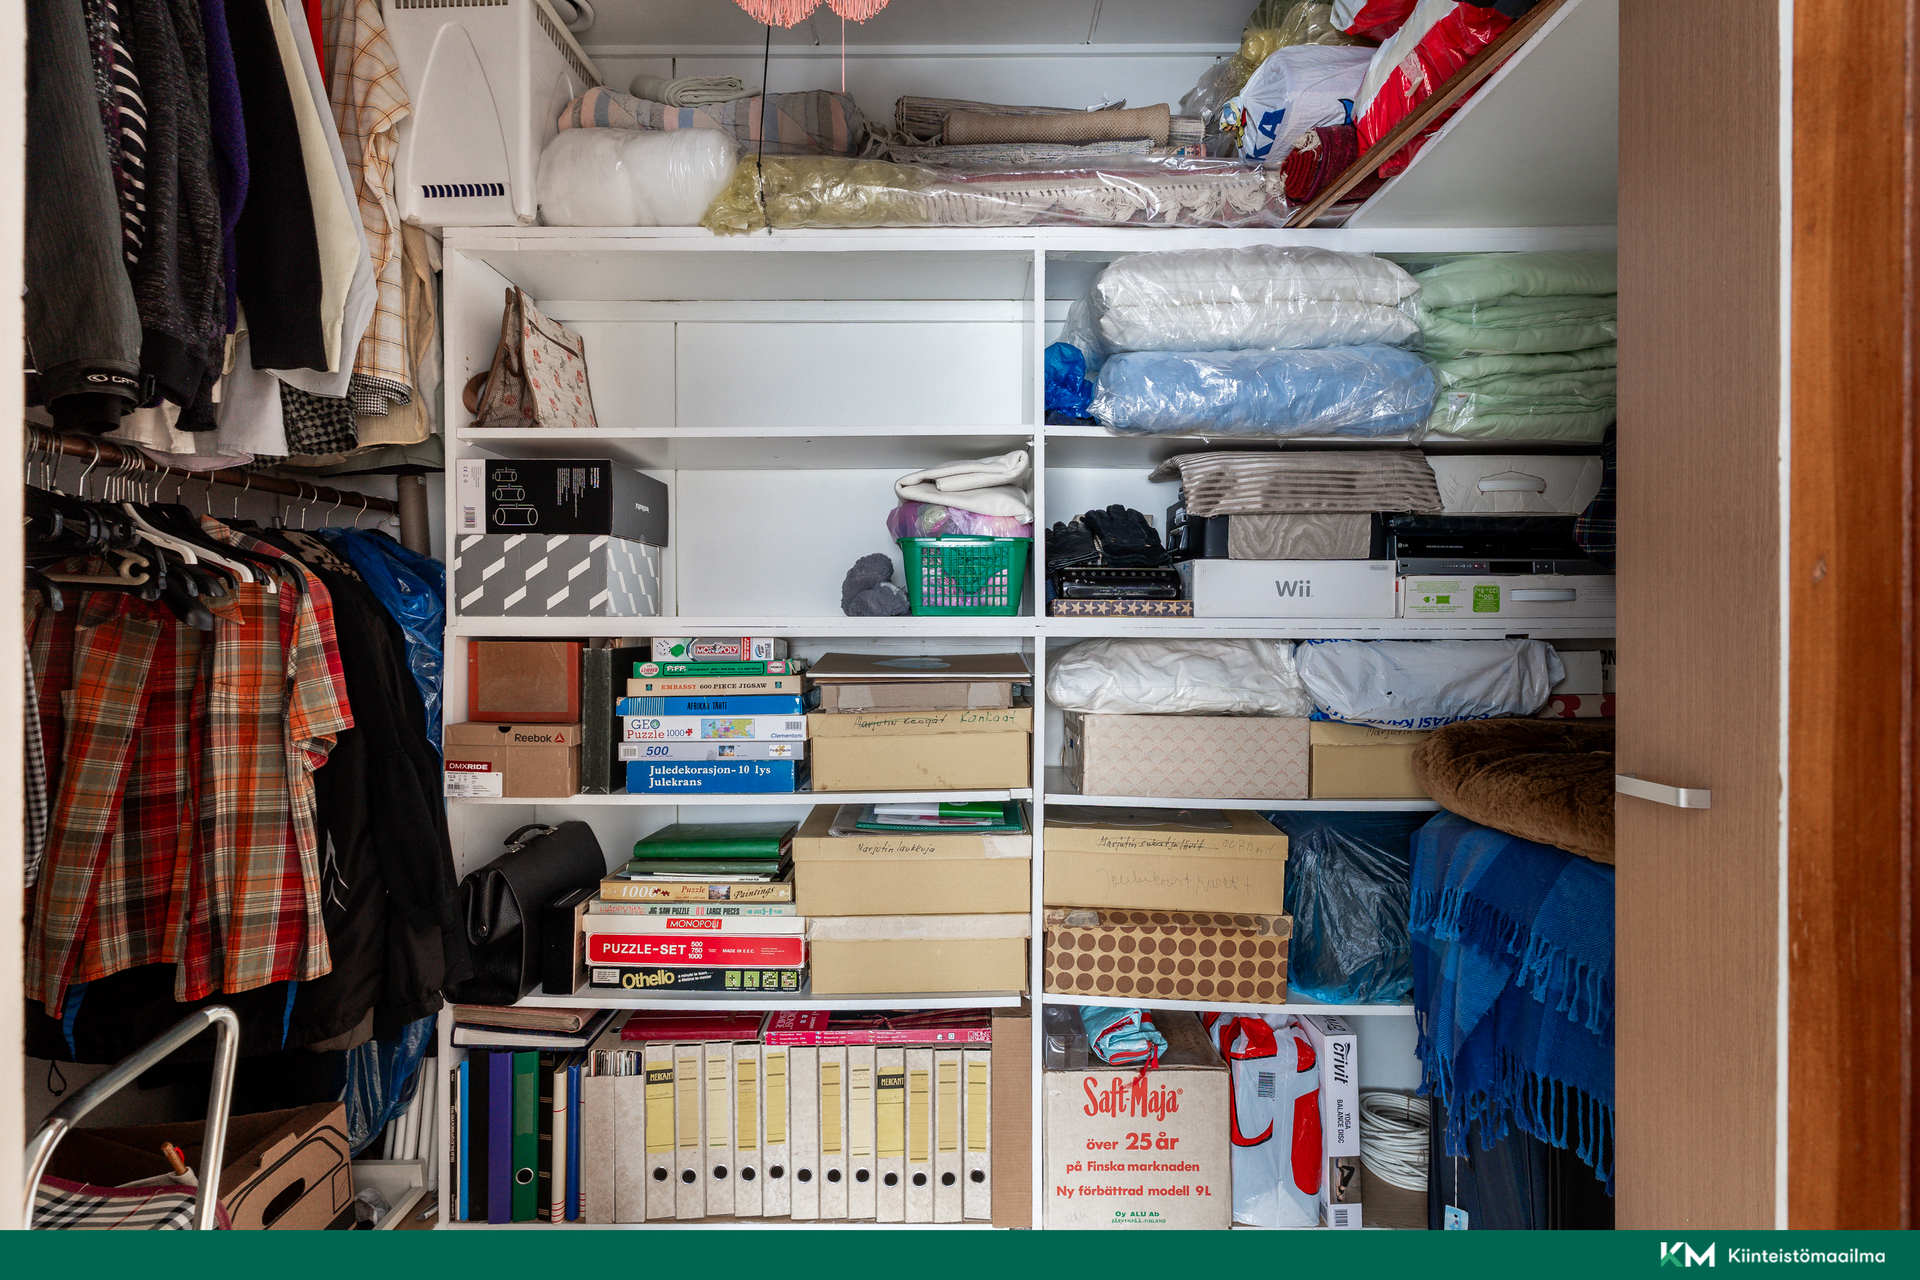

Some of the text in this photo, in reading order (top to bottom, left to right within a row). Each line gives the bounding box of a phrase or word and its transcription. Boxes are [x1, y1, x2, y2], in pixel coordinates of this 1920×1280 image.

[1275, 580, 1311, 598] Wii
[696, 645, 739, 655] MONOPOLY
[687, 701, 727, 710] AFRIKAN TÄHTI
[631, 719, 660, 730] GEO
[514, 734, 552, 742] Reebok
[627, 729, 685, 739] Puzzle 1000
[646, 746, 669, 756] 500
[449, 762, 488, 770] DMXRIDE
[738, 765, 750, 774] 10
[755, 765, 771, 775] lys
[649, 777, 702, 788] Julekrans
[620, 886, 658, 898] 1000
[734, 886, 776, 899] Paintings
[696, 906, 704, 916] 88
[706, 907, 722, 915] LARGE
[723, 907, 740, 915] PIECES
[670, 920, 719, 929] MONOPOLI
[603, 943, 686, 955] PUZZLE-SET
[622, 970, 675, 989] Othello
[1333, 1042, 1349, 1086] crivit
[1086, 1132, 1180, 1150] över 25 år
[1066, 1161, 1200, 1174] på Finska marknaden
[1056, 1186, 1212, 1198] Ny förbättrad modell 9L
